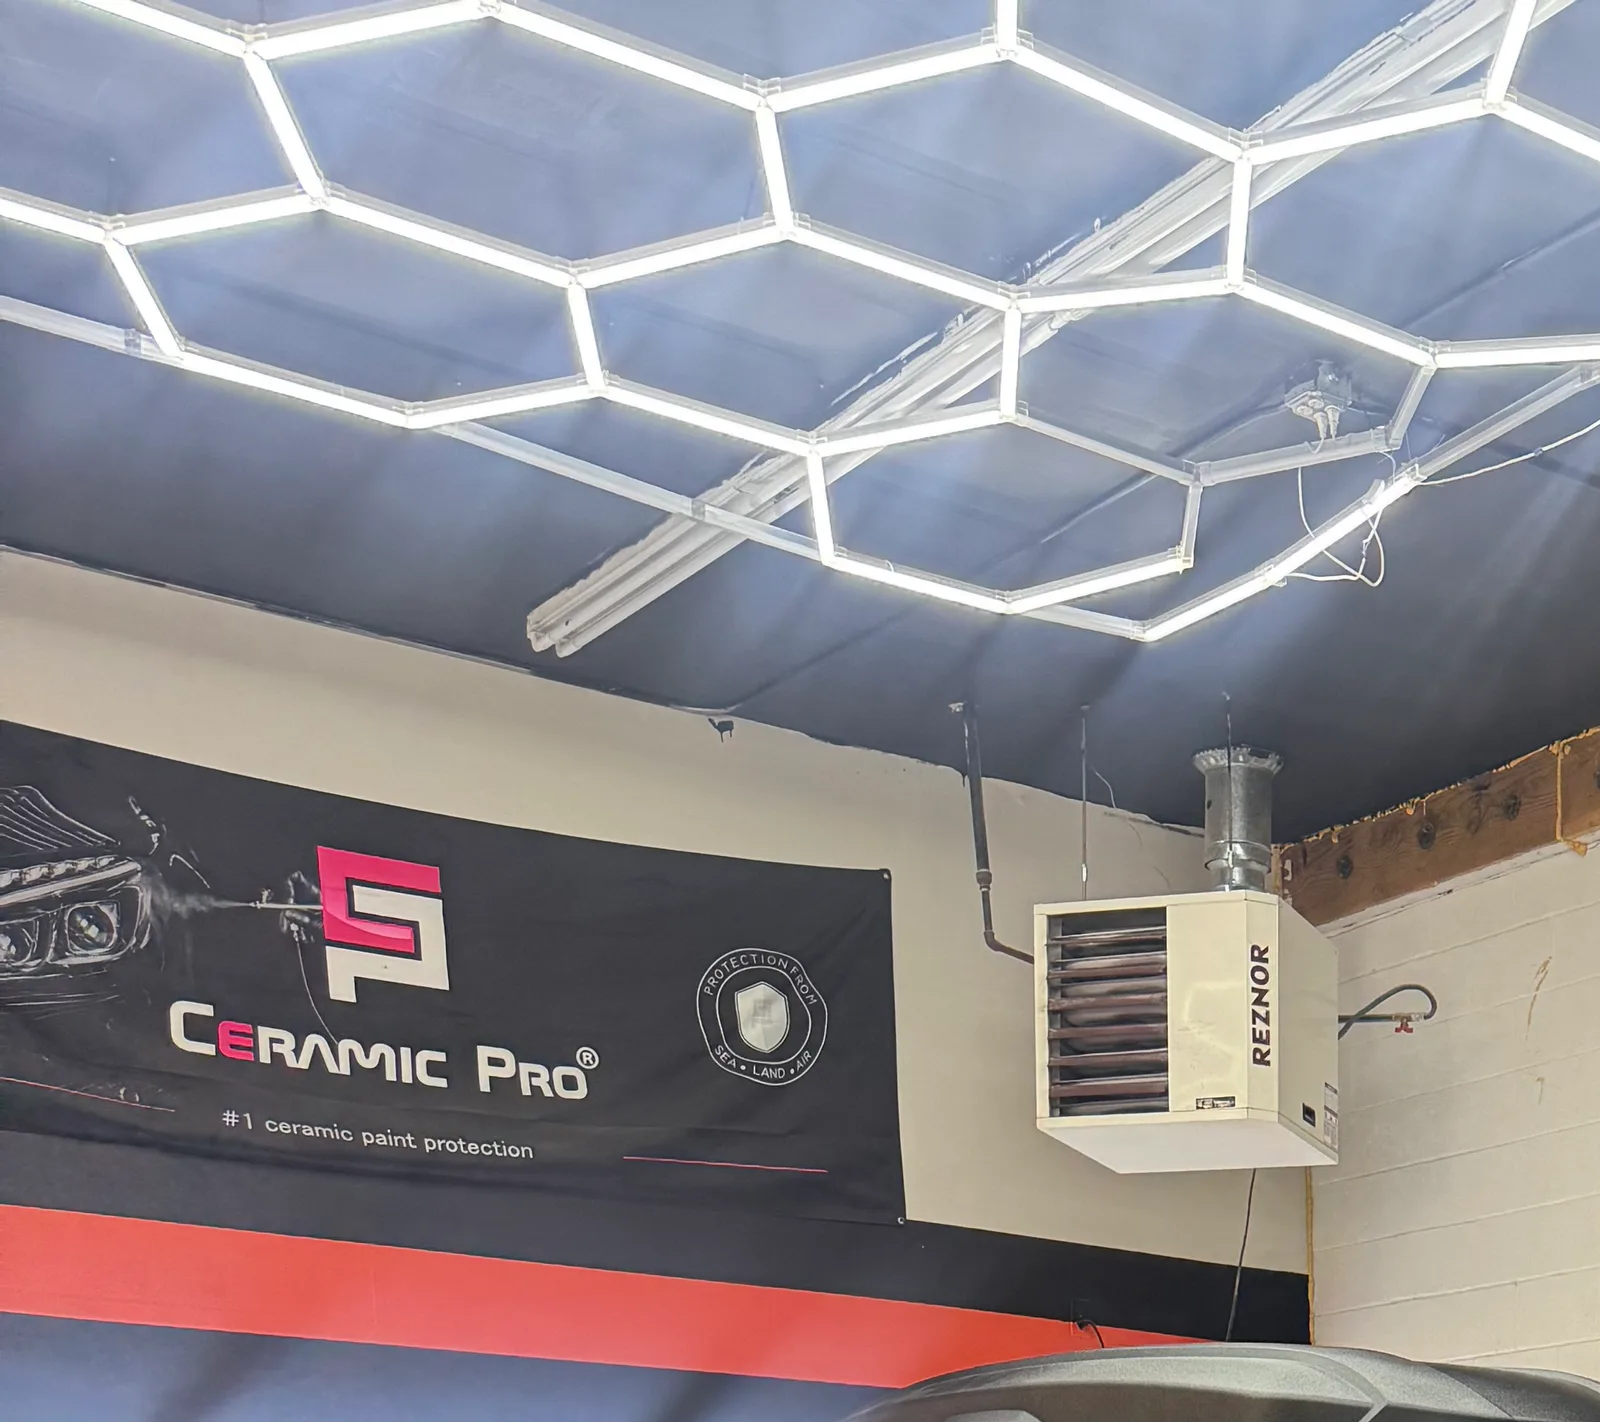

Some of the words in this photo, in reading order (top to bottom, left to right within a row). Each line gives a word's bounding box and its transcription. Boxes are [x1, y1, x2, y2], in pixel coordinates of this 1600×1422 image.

[703, 953, 789, 996] PROTECTION
[789, 966, 818, 1005] FROM
[1249, 943, 1271, 1067] REZNOR
[714, 1044, 737, 1069] SEA
[752, 1064, 786, 1080] LAND
[796, 1050, 813, 1071] AIR
[221, 1108, 254, 1131] #1
[265, 1117, 354, 1143] ceramic
[361, 1129, 417, 1151] paint
[424, 1136, 534, 1160] protection
